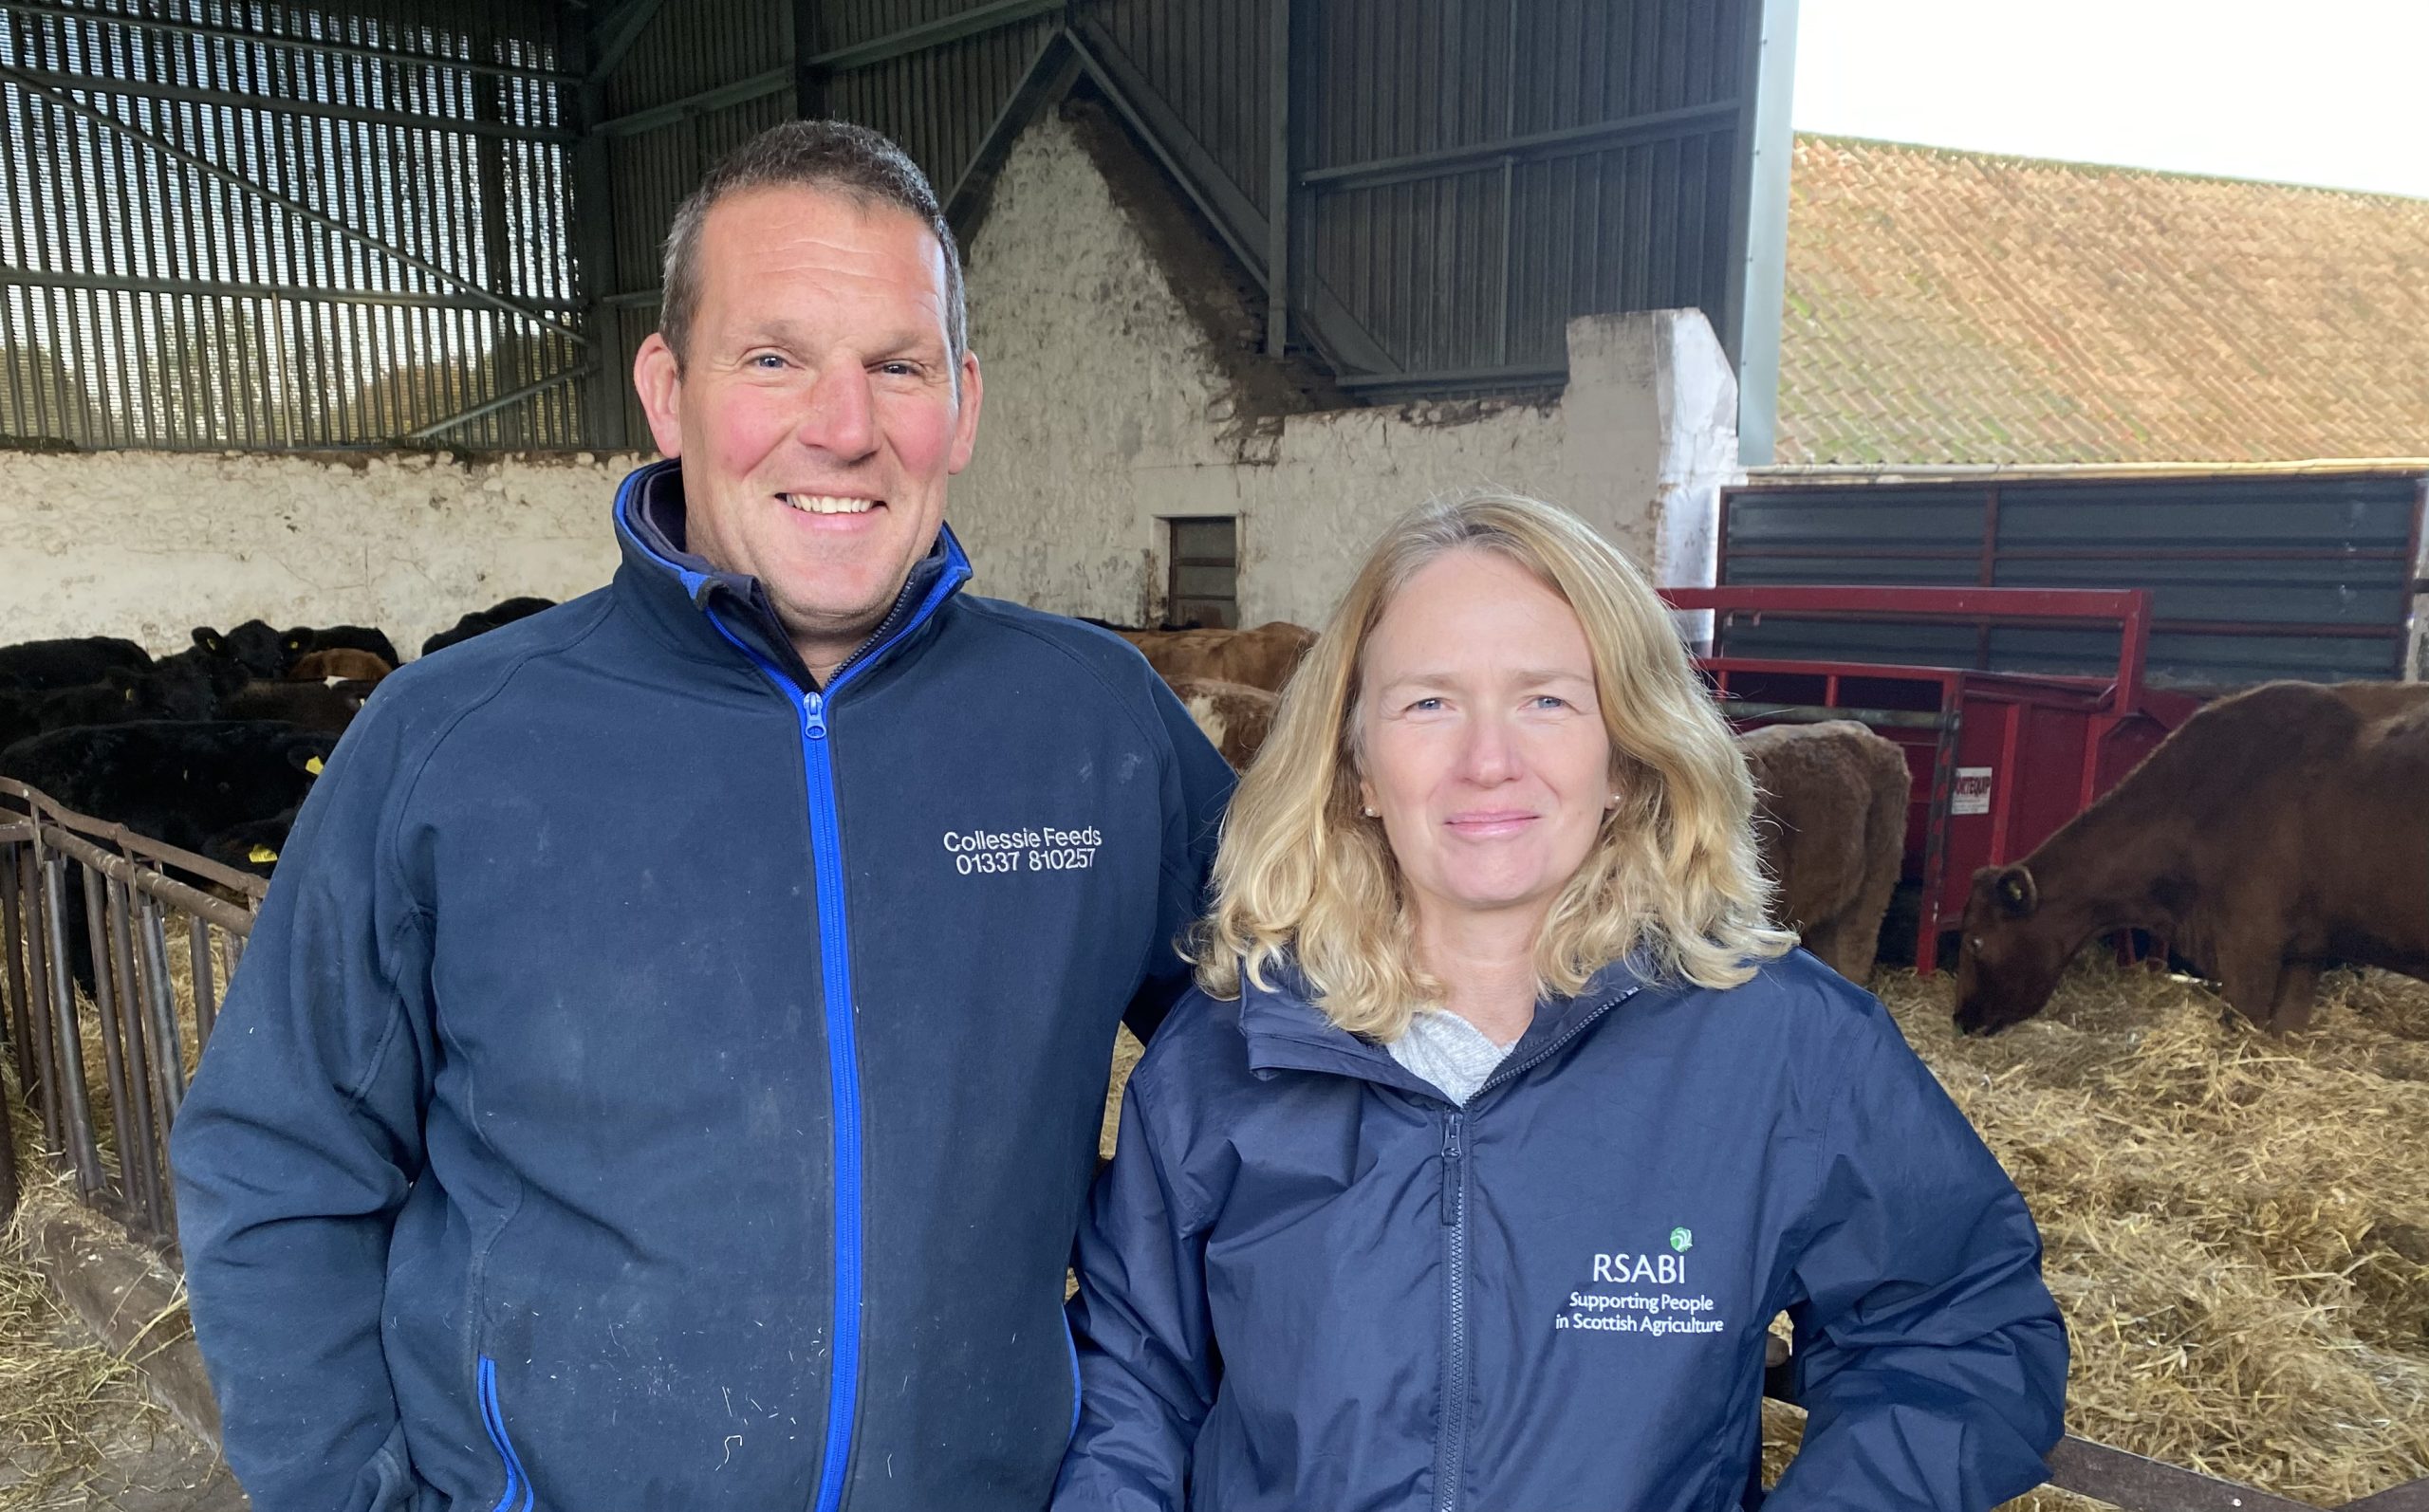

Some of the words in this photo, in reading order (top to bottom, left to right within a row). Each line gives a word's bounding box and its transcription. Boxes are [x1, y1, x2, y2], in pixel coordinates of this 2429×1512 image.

[1956, 776, 1991, 796] ORTEQUIP
[943, 827, 1042, 852] Collessie
[1044, 825, 1103, 847] Feeds
[955, 851, 1020, 875] 01337
[1029, 848, 1096, 871] 810257
[1593, 1253, 1685, 1284] RSABI
[1569, 1291, 1660, 1314] Supporting
[1661, 1294, 1715, 1315] People
[1555, 1314, 1569, 1330] in
[1572, 1313, 1638, 1332] Scottish
[1640, 1316, 1724, 1337] Agriculture
